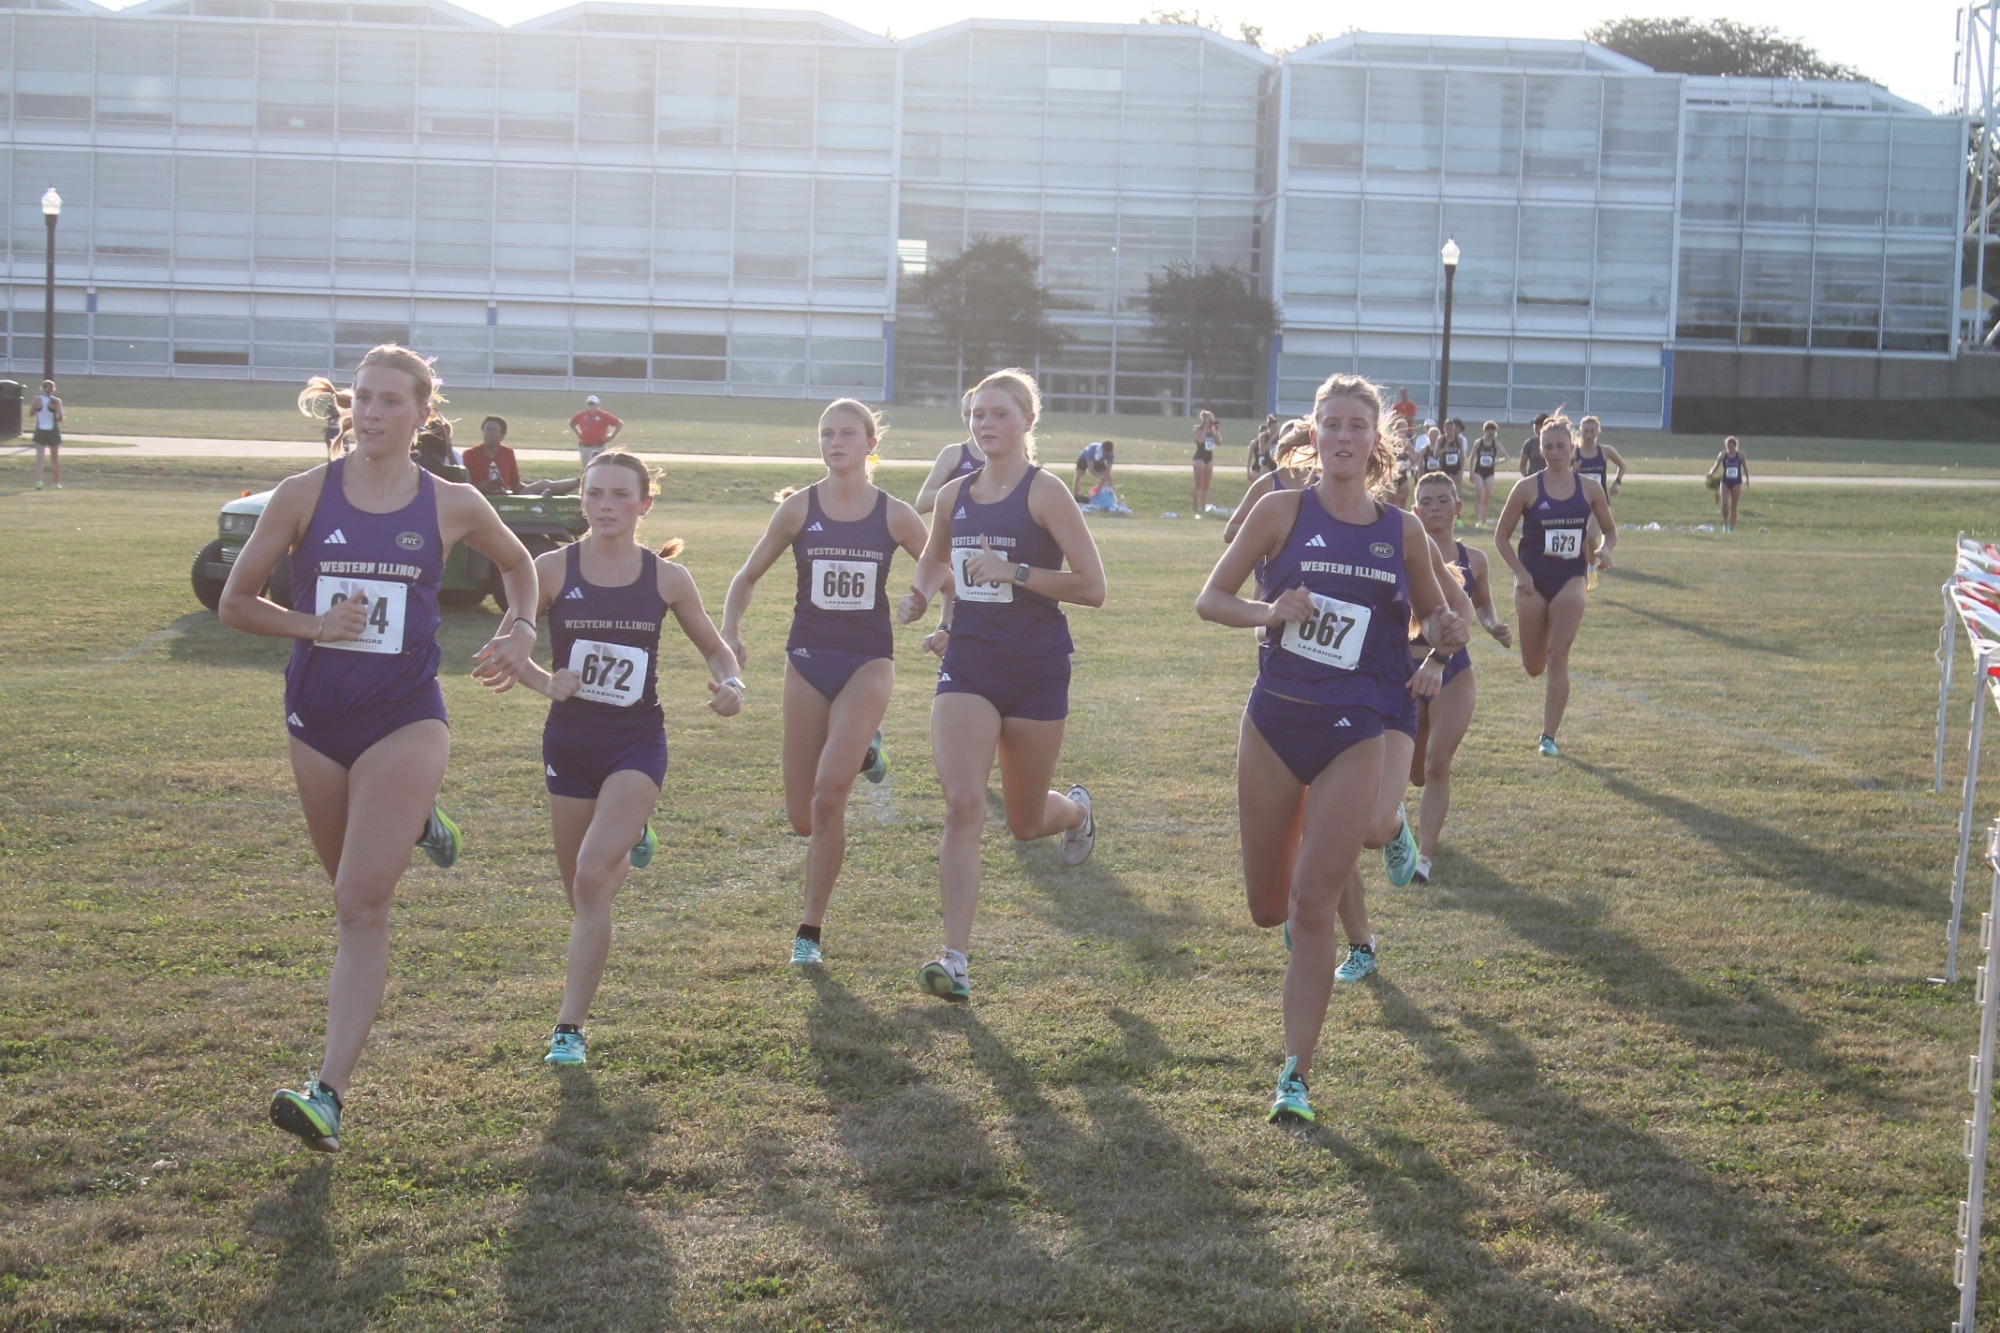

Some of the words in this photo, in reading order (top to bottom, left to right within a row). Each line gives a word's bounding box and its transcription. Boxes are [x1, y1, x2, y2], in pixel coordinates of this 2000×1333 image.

[1552, 535, 1576, 552] 673
[807, 547, 847, 556] WESTERN
[848, 549, 884, 560] ILLINOIS
[320, 561, 375, 574] WESTERN
[378, 563, 422, 579] ILLINOS
[1300, 561, 1352, 575] WESTERN
[1354, 566, 1397, 584] ILLINOIS
[823, 570, 865, 598] 666
[564, 620, 613, 629] WESTERN
[615, 621, 656, 631] ILLINOIS
[1299, 607, 1356, 650] 667
[1297, 643, 1343, 660] LAKESHORE
[581, 653, 634, 692] 672
[581, 689, 626, 700] LAKESHORE
